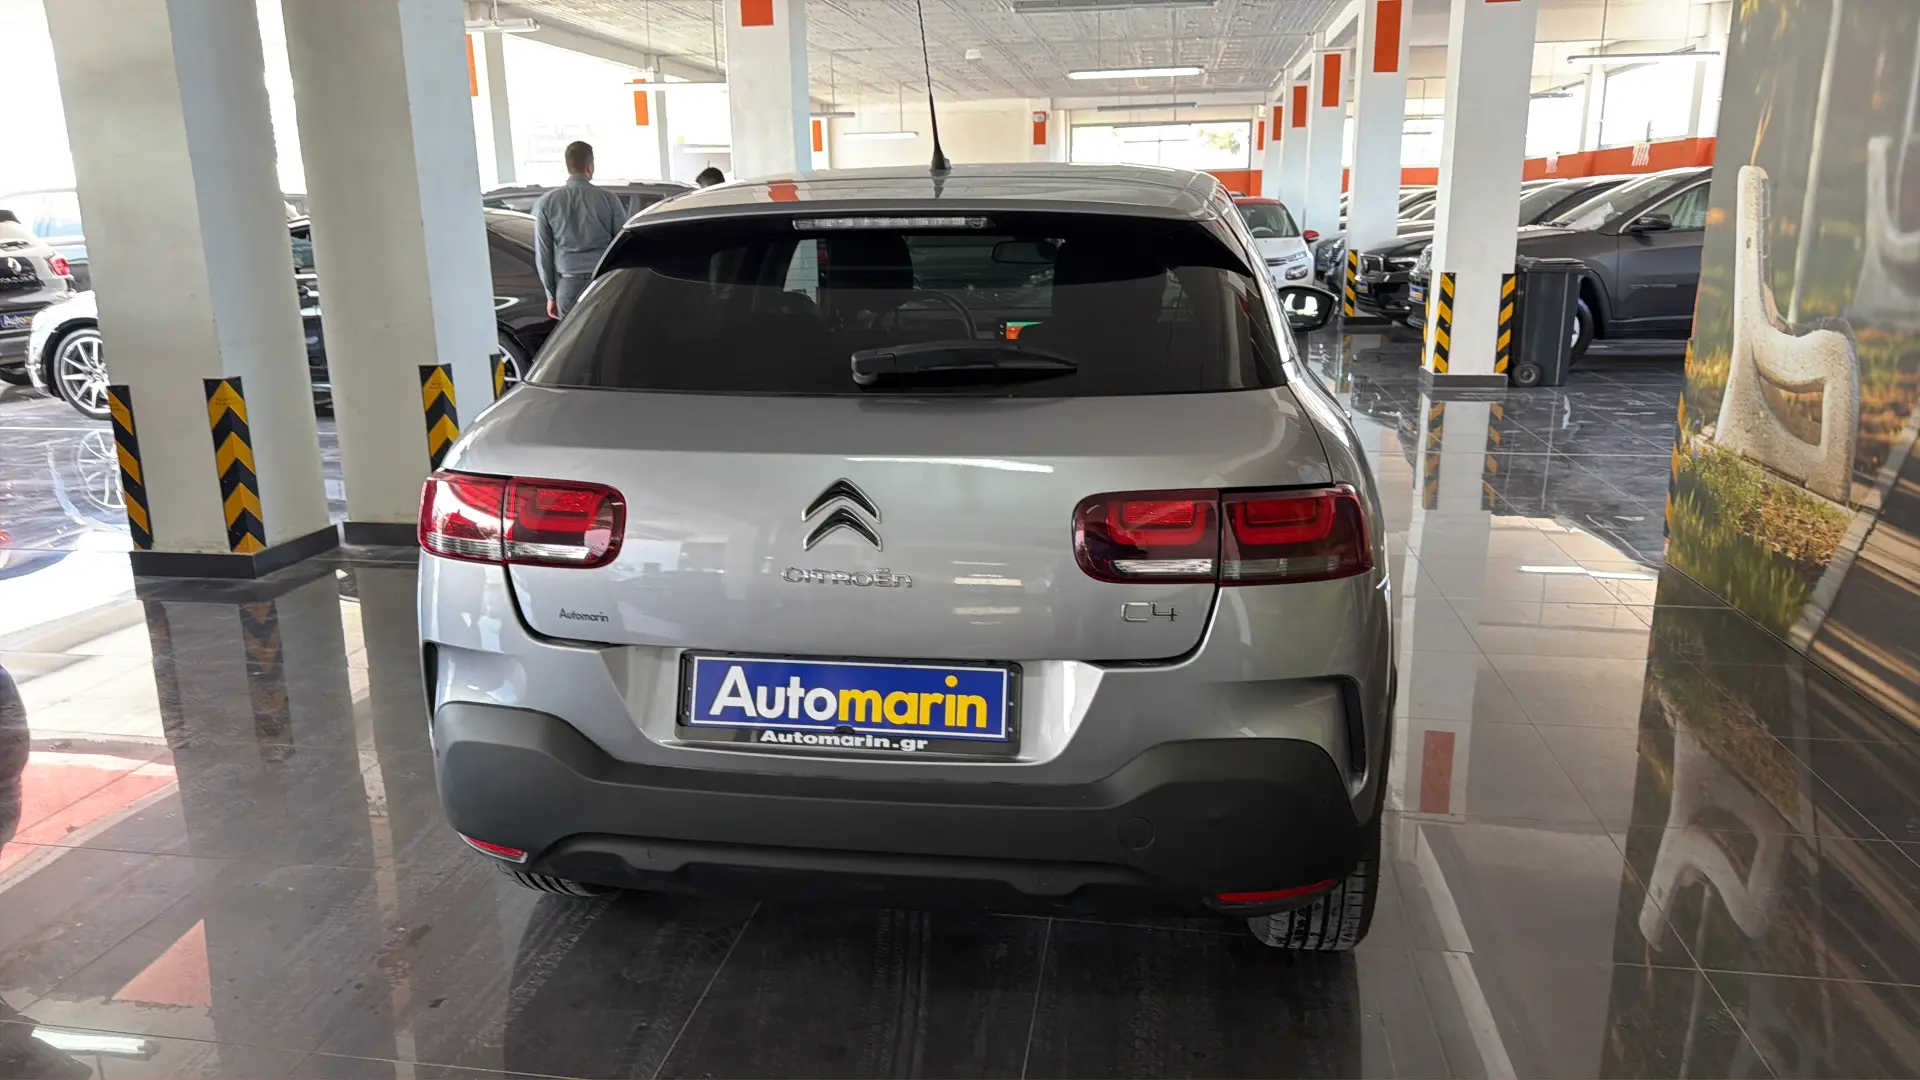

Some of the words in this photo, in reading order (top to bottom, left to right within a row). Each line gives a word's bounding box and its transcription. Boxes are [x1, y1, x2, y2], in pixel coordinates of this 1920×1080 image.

[559, 608, 609, 622] Automarin
[1121, 601, 1179, 622] C4
[709, 665, 988, 728] Automarin
[760, 730, 928, 751] Automarin.gr
